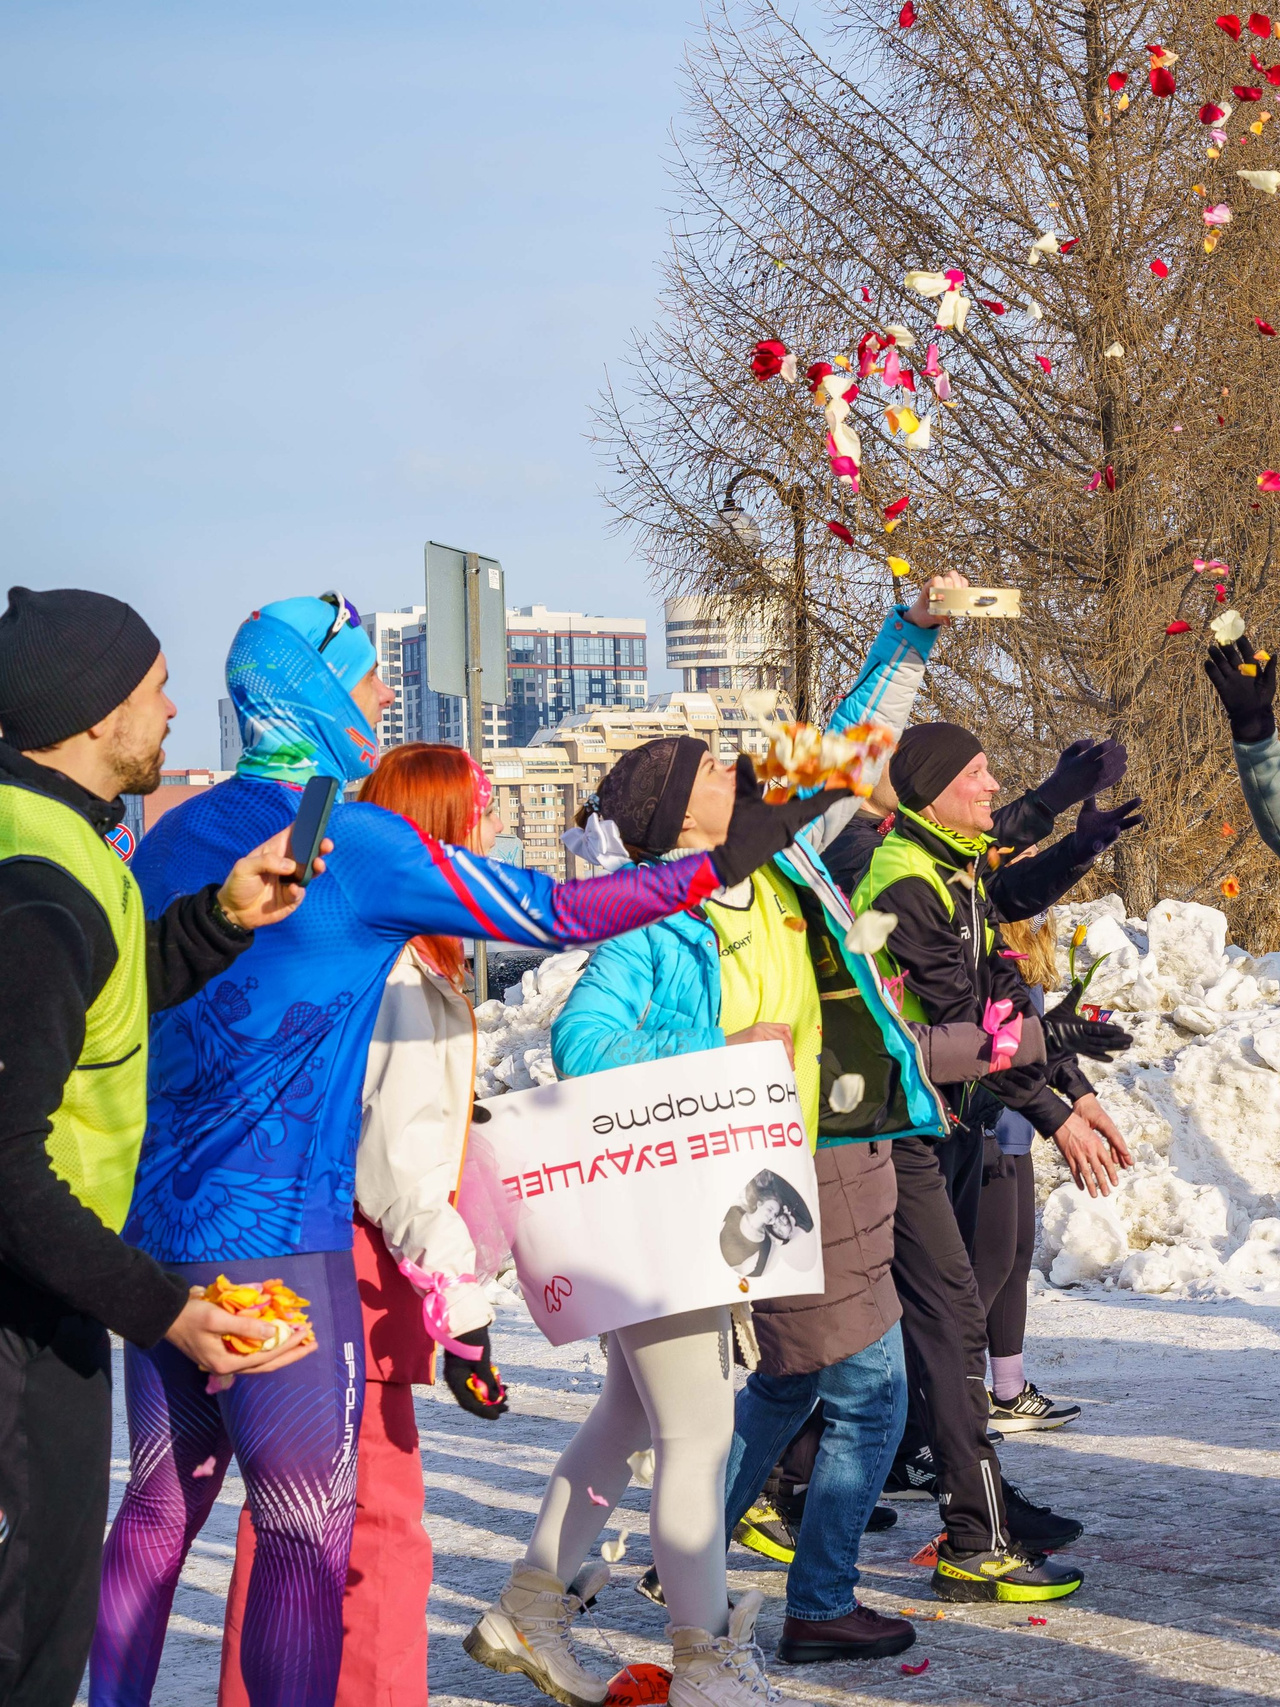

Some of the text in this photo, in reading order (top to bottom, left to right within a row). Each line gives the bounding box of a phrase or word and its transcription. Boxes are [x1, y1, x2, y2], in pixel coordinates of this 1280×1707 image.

[719, 931, 752, 957] олонт
[592, 1083, 799, 1135] на старте
[501, 1121, 803, 1200] ОБЩЕЕ БУДУЩЕЕ
